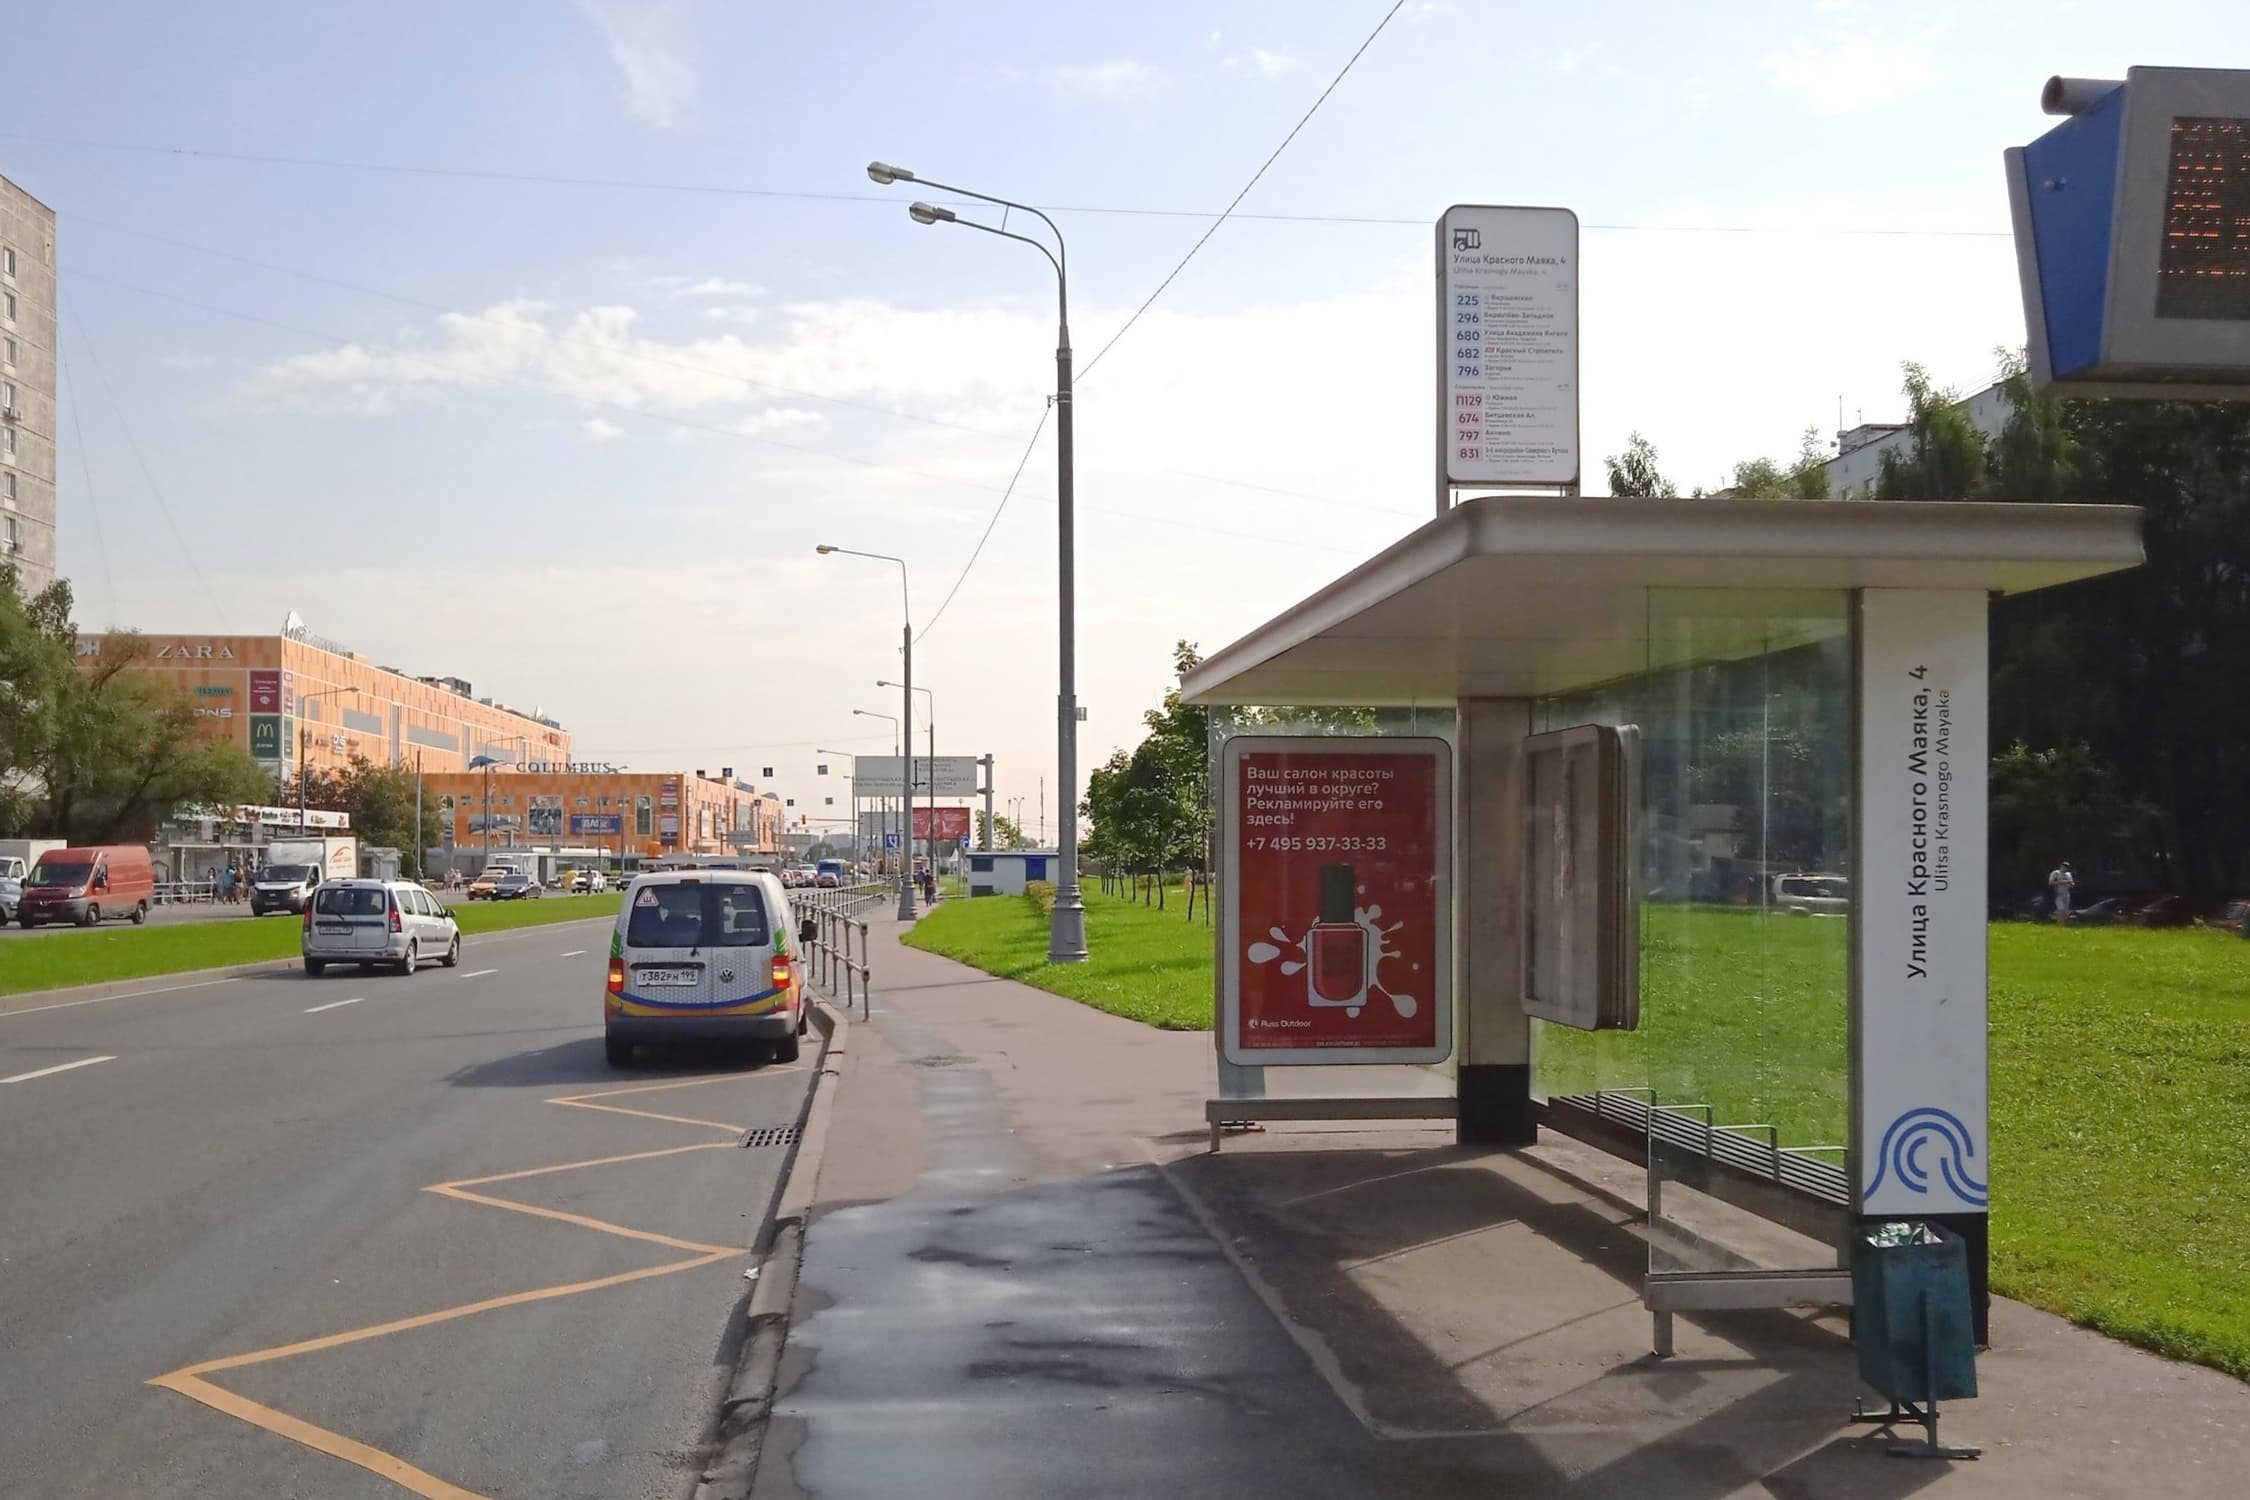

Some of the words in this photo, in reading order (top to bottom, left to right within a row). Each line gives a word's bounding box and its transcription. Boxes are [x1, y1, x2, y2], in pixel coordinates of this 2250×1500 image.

[1453, 254, 1481, 264] Улица
[1483, 255, 1524, 265] Красного
[1560, 255, 1566, 264] 4
[1457, 295, 1479, 306] 225
[1457, 313, 1480, 324] 296
[1456, 330, 1480, 341] 680
[1457, 348, 1480, 359] 682
[1457, 366, 1480, 376] 796
[1456, 395, 1482, 407] П129
[1458, 413, 1479, 424] 674
[1459, 431, 1480, 441] 797
[1459, 448, 1479, 459] 831
[156, 644, 234, 660] ZARA
[1908, 665, 1928, 680] 4
[1935, 690, 1952, 756] Mayaka
[1908, 688, 1932, 776] Маяка,
[516, 762, 611, 774] COLUMBUS
[1247, 766, 1279, 779] Ваш
[1283, 769, 1327, 779] салон
[1332, 769, 1394, 781] красоты
[1246, 782, 1305, 797] лучший
[1309, 784, 1318, 794] в
[1322, 782, 1379, 797] округе?
[1247, 796, 1354, 812] Рекламируйте
[1358, 799, 1383, 809] его
[1935, 761, 1952, 839] Krasnogo
[1247, 812, 1294, 826] здесь!
[1247, 837, 1266, 850] +7
[1270, 837, 1301, 850] 495
[1305, 837, 1386, 850] 937-33-33
[1907, 782, 1931, 895] Красного
[1935, 846, 1949, 892] Ulitsa
[1907, 904, 1930, 979] Улица
[1280, 1019, 1312, 1028] Outdoor
